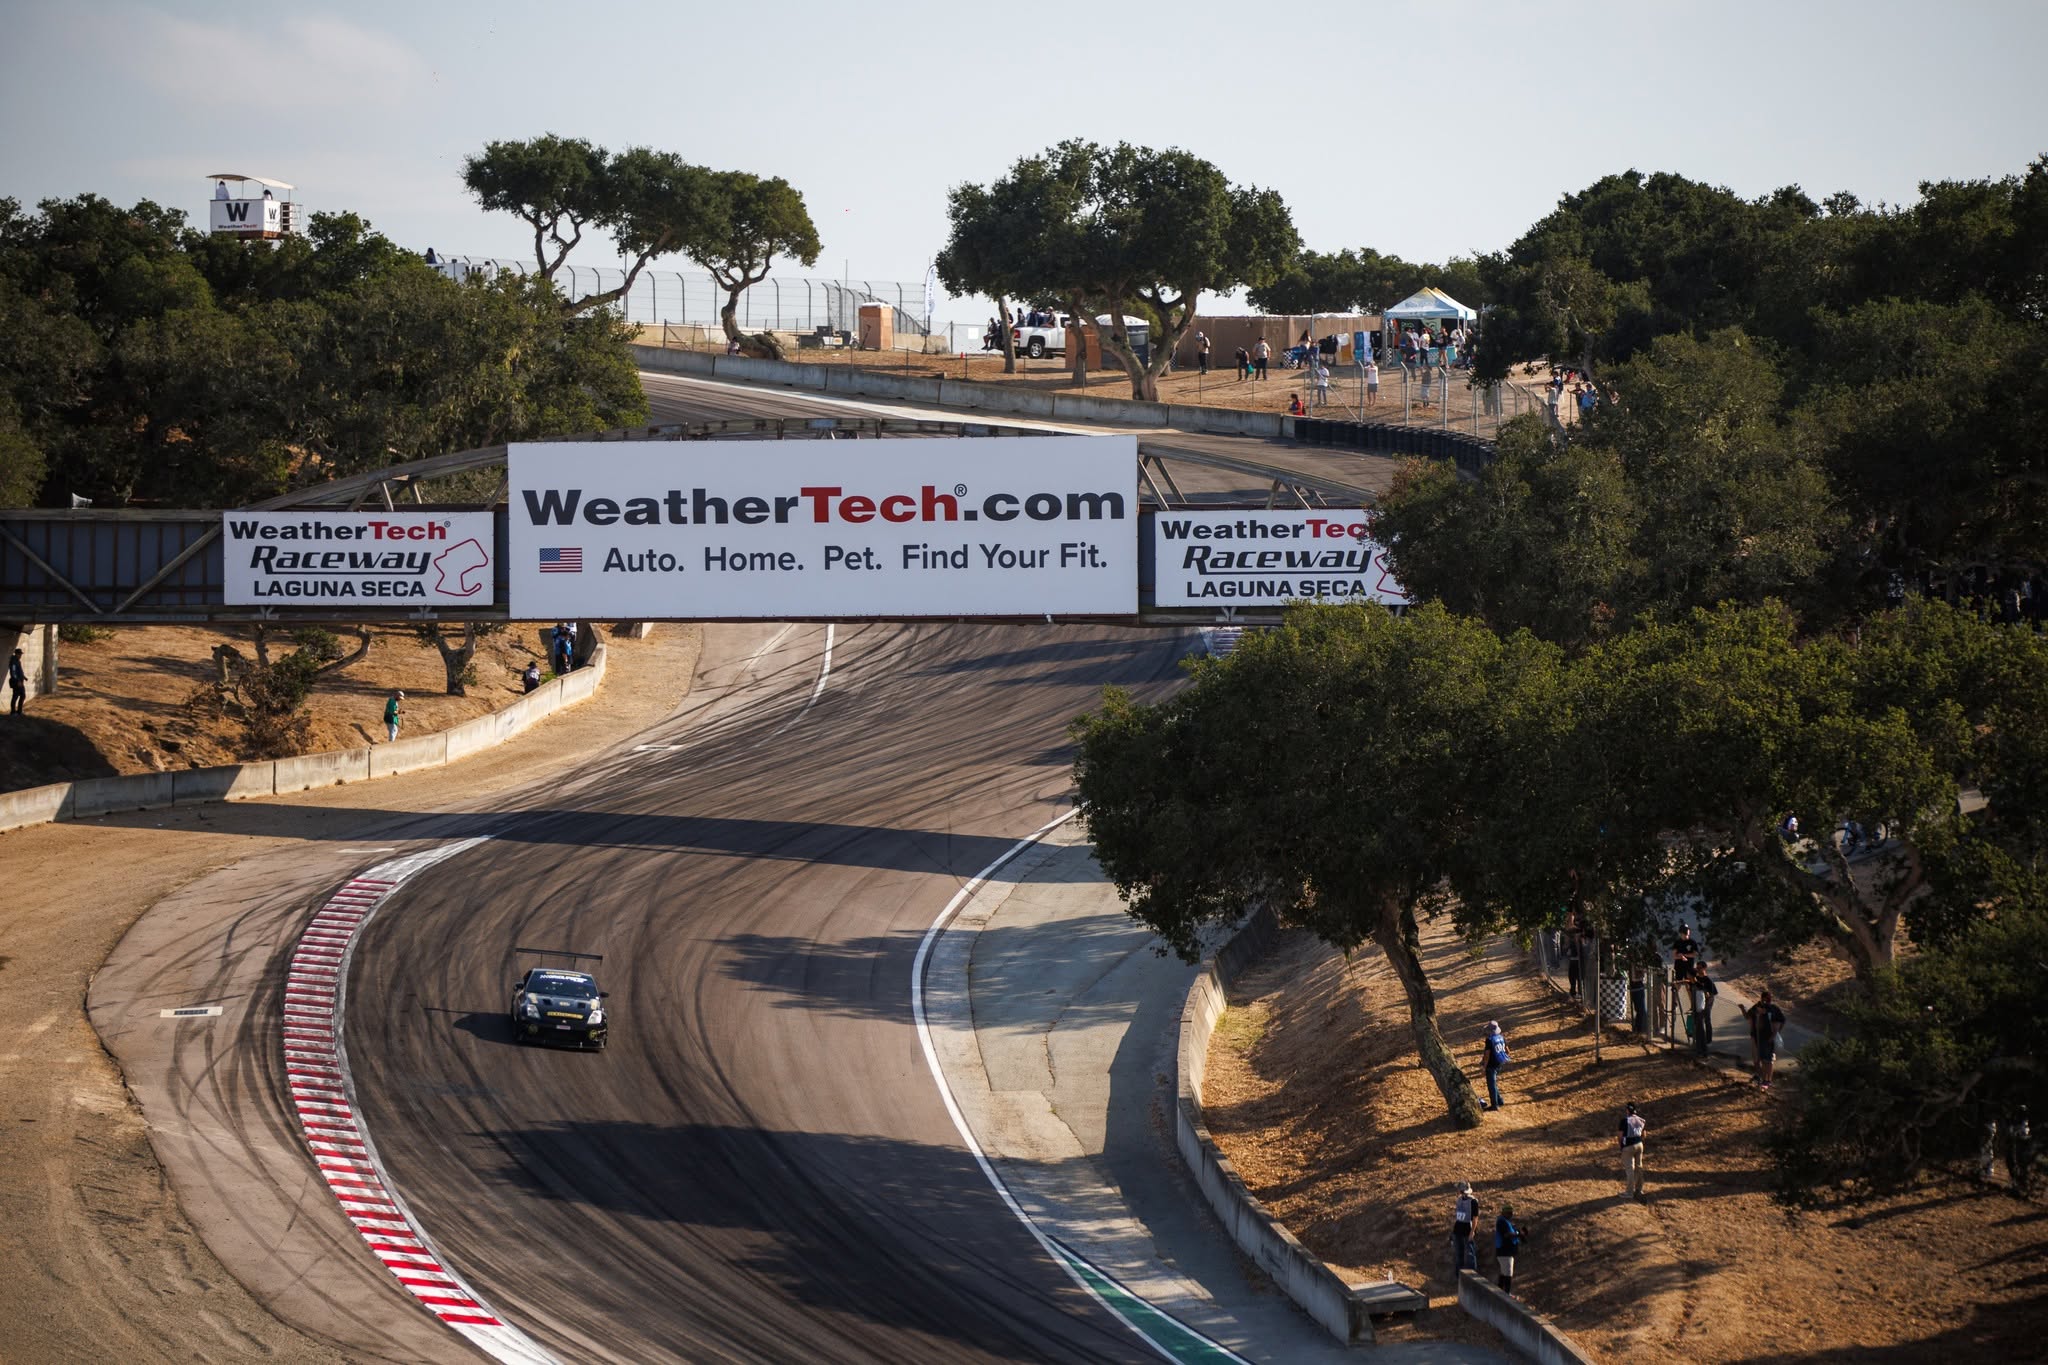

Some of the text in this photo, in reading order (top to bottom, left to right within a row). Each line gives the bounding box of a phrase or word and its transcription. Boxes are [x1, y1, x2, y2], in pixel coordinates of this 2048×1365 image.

[226, 203, 249, 221] W
[250, 545, 431, 575] Raceway
[603, 542, 1107, 573] Auto. Home. Pet. Find Your Fit.
[1182, 545, 1373, 576] Raceway
[254, 580, 427, 597] LAGUNA SECA
[1187, 580, 1367, 598] LAGUNA SECA
